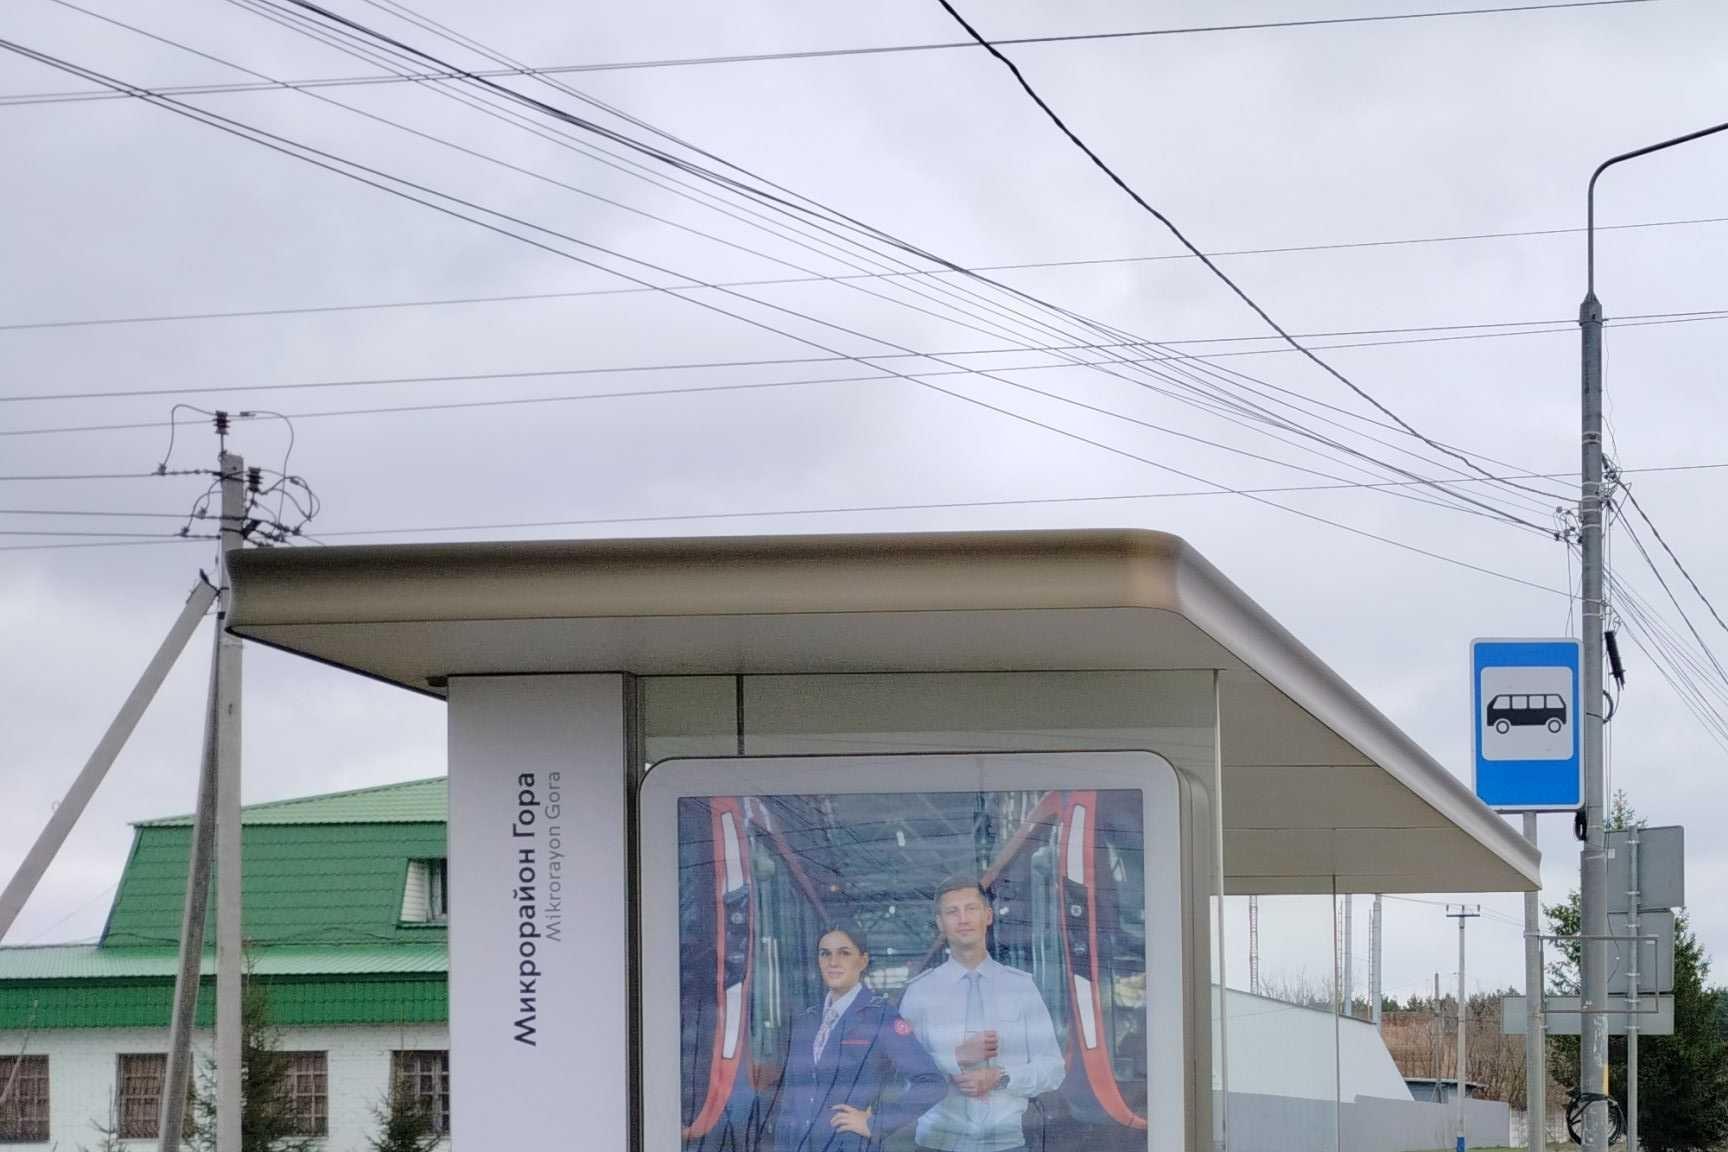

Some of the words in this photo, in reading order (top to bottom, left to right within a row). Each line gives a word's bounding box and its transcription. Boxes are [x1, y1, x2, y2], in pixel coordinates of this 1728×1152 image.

[512, 772, 541, 838] Гора
[545, 771, 561, 818] Gora
[545, 826, 567, 942] Mikrorayon
[513, 848, 541, 1047] Микрорайон
